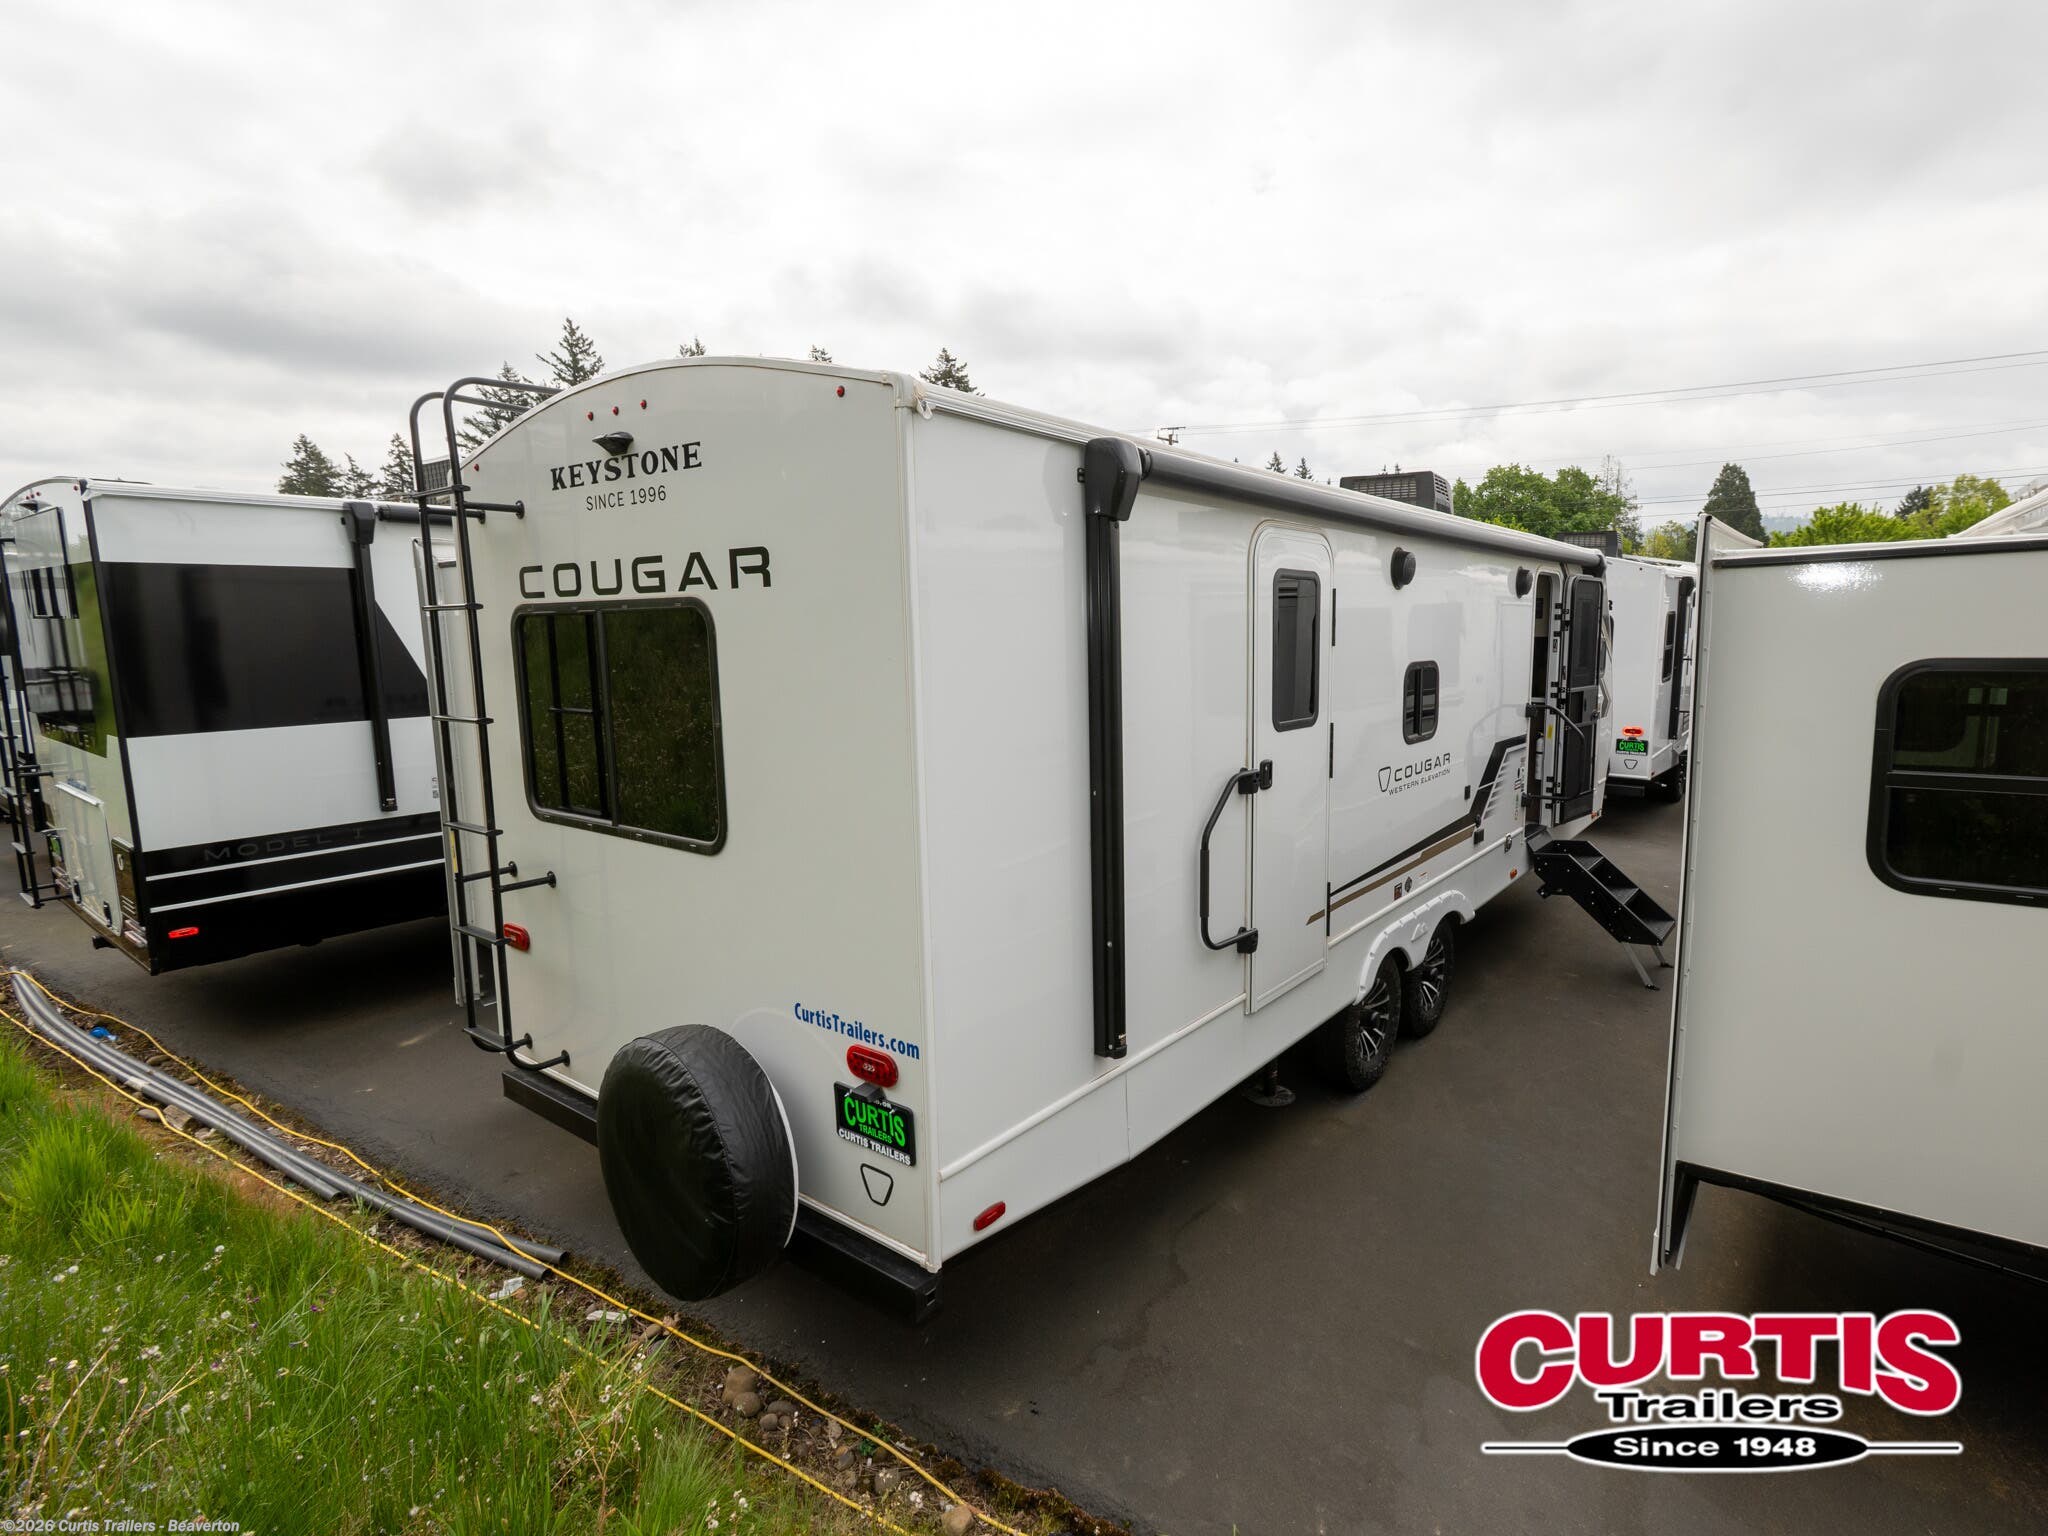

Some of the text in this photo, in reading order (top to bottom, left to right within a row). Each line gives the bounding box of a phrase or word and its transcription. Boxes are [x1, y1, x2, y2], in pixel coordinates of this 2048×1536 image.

[551, 441, 702, 491] KEYSTONE
[586, 485, 667, 511] SINCE 1996
[518, 546, 772, 599] COUGAR
[1388, 768, 1451, 796] WESTERN ELEVATION
[1394, 752, 1451, 782] COUGAR
[204, 831, 333, 862] MODEL
[794, 1002, 921, 1060] CurtisTrailers.com
[844, 1096, 906, 1147] CURTIS
[859, 1123, 893, 1144] TRAILERS
[838, 1128, 911, 1166] CURTIS TRAILERS
